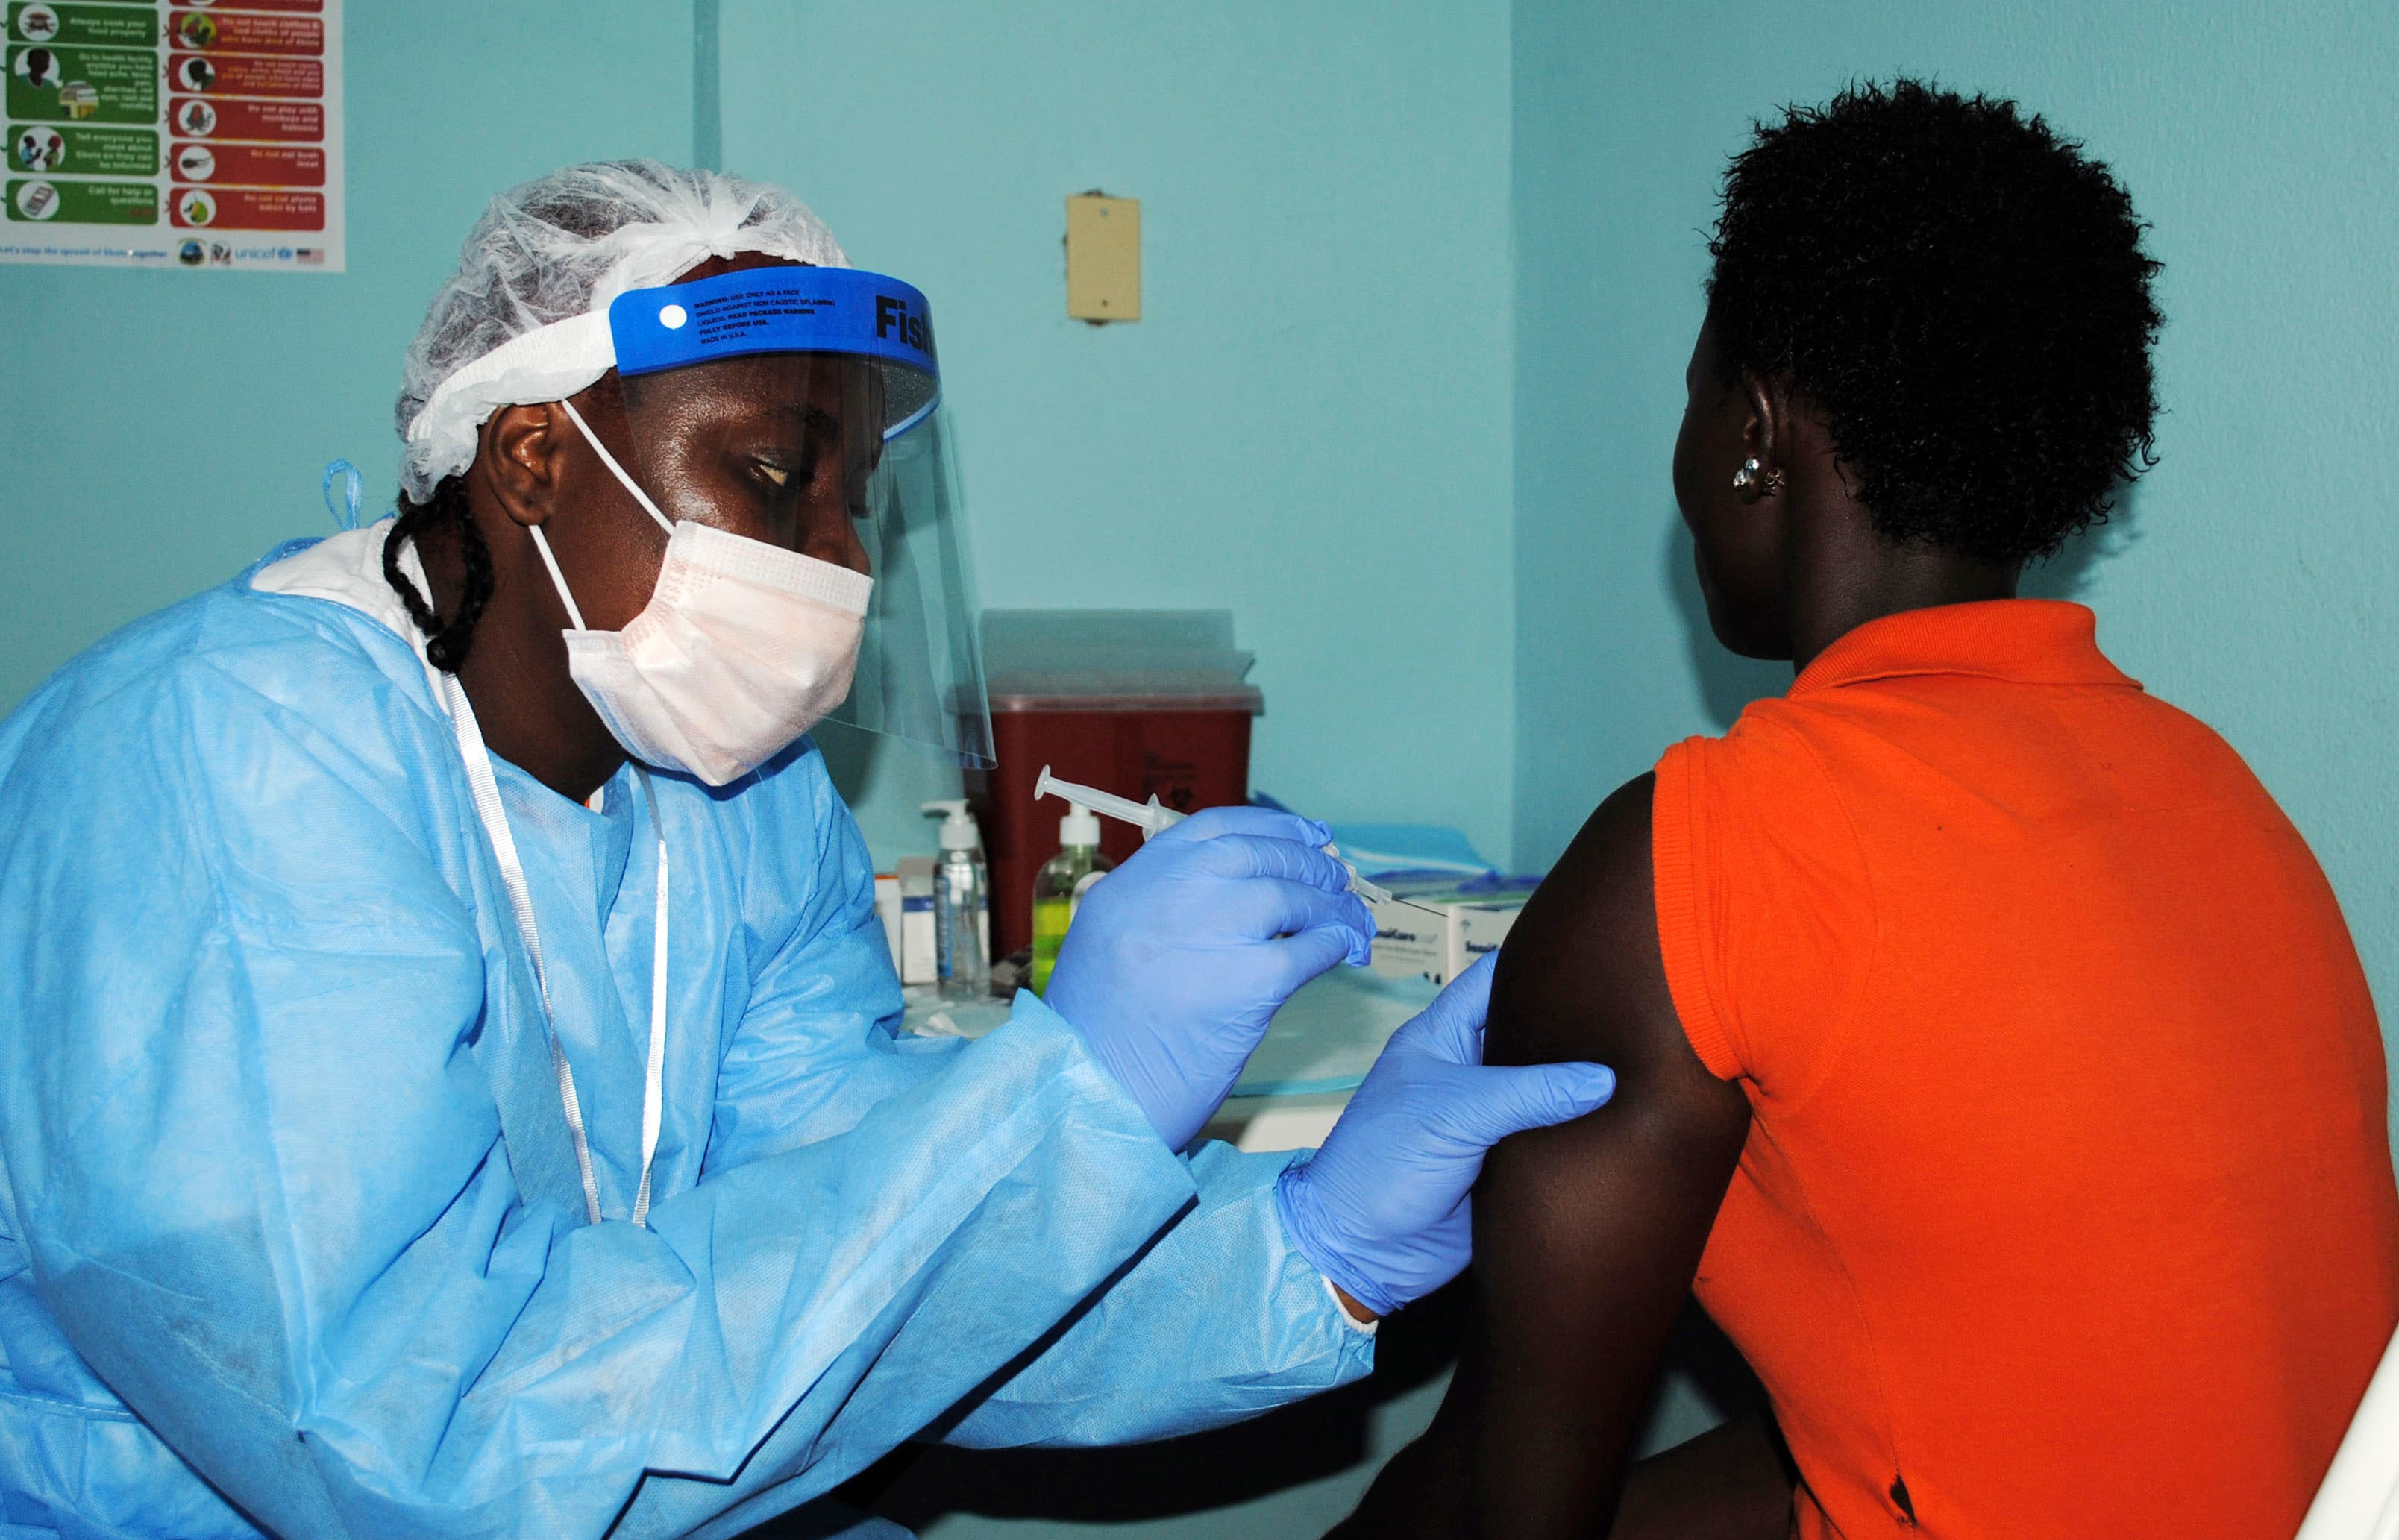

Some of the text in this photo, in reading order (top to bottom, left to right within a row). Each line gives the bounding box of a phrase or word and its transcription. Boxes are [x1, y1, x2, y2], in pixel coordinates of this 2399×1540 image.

[128, 249, 167, 258] ogether
[235, 245, 275, 258] unicef
[730, 293, 745, 301] USE
[696, 307, 721, 318] SHIELD
[722, 301, 752, 312] AGAINST
[727, 312, 748, 320] READ
[749, 309, 782, 317] PACKAGE
[699, 326, 721, 336] FULLY
[722, 321, 752, 330] BEFORE
[701, 336, 719, 344] MADE
